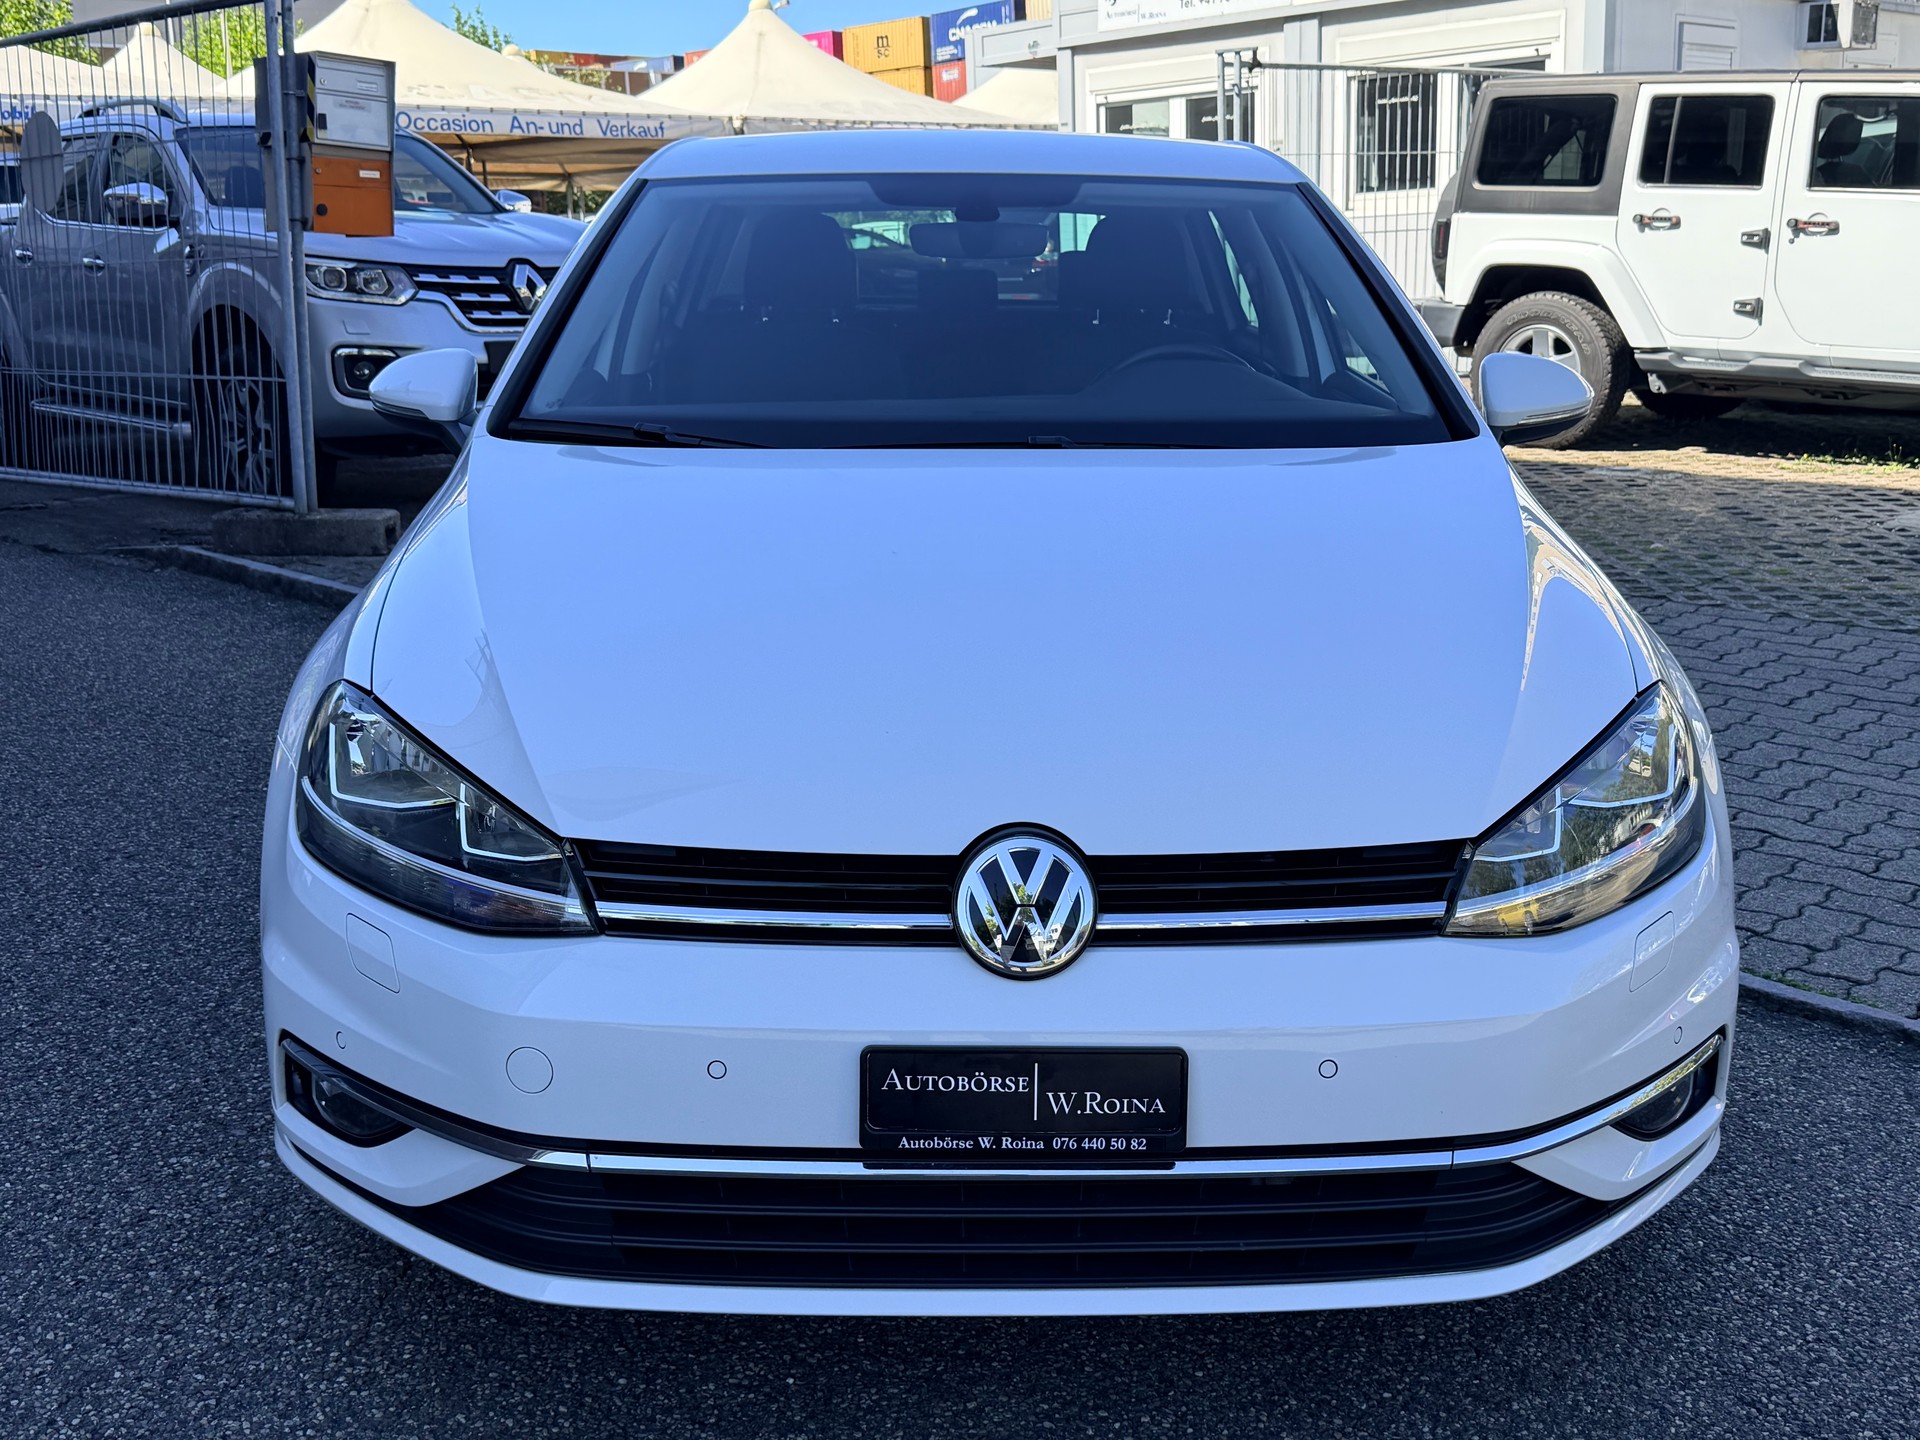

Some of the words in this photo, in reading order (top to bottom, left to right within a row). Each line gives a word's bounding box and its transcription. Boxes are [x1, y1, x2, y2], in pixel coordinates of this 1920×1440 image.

[395, 111, 494, 133] Occasion
[597, 119, 666, 138] Verkauf
[898, 1136, 974, 1149] Autobörse
[978, 1136, 996, 1149] W.
[1001, 1136, 1045, 1150] Roina
[1052, 1137, 1077, 1150] 076
[1081, 1137, 1106, 1150] 440
[1109, 1138, 1126, 1150] 50
[1130, 1138, 1147, 1150] 82
